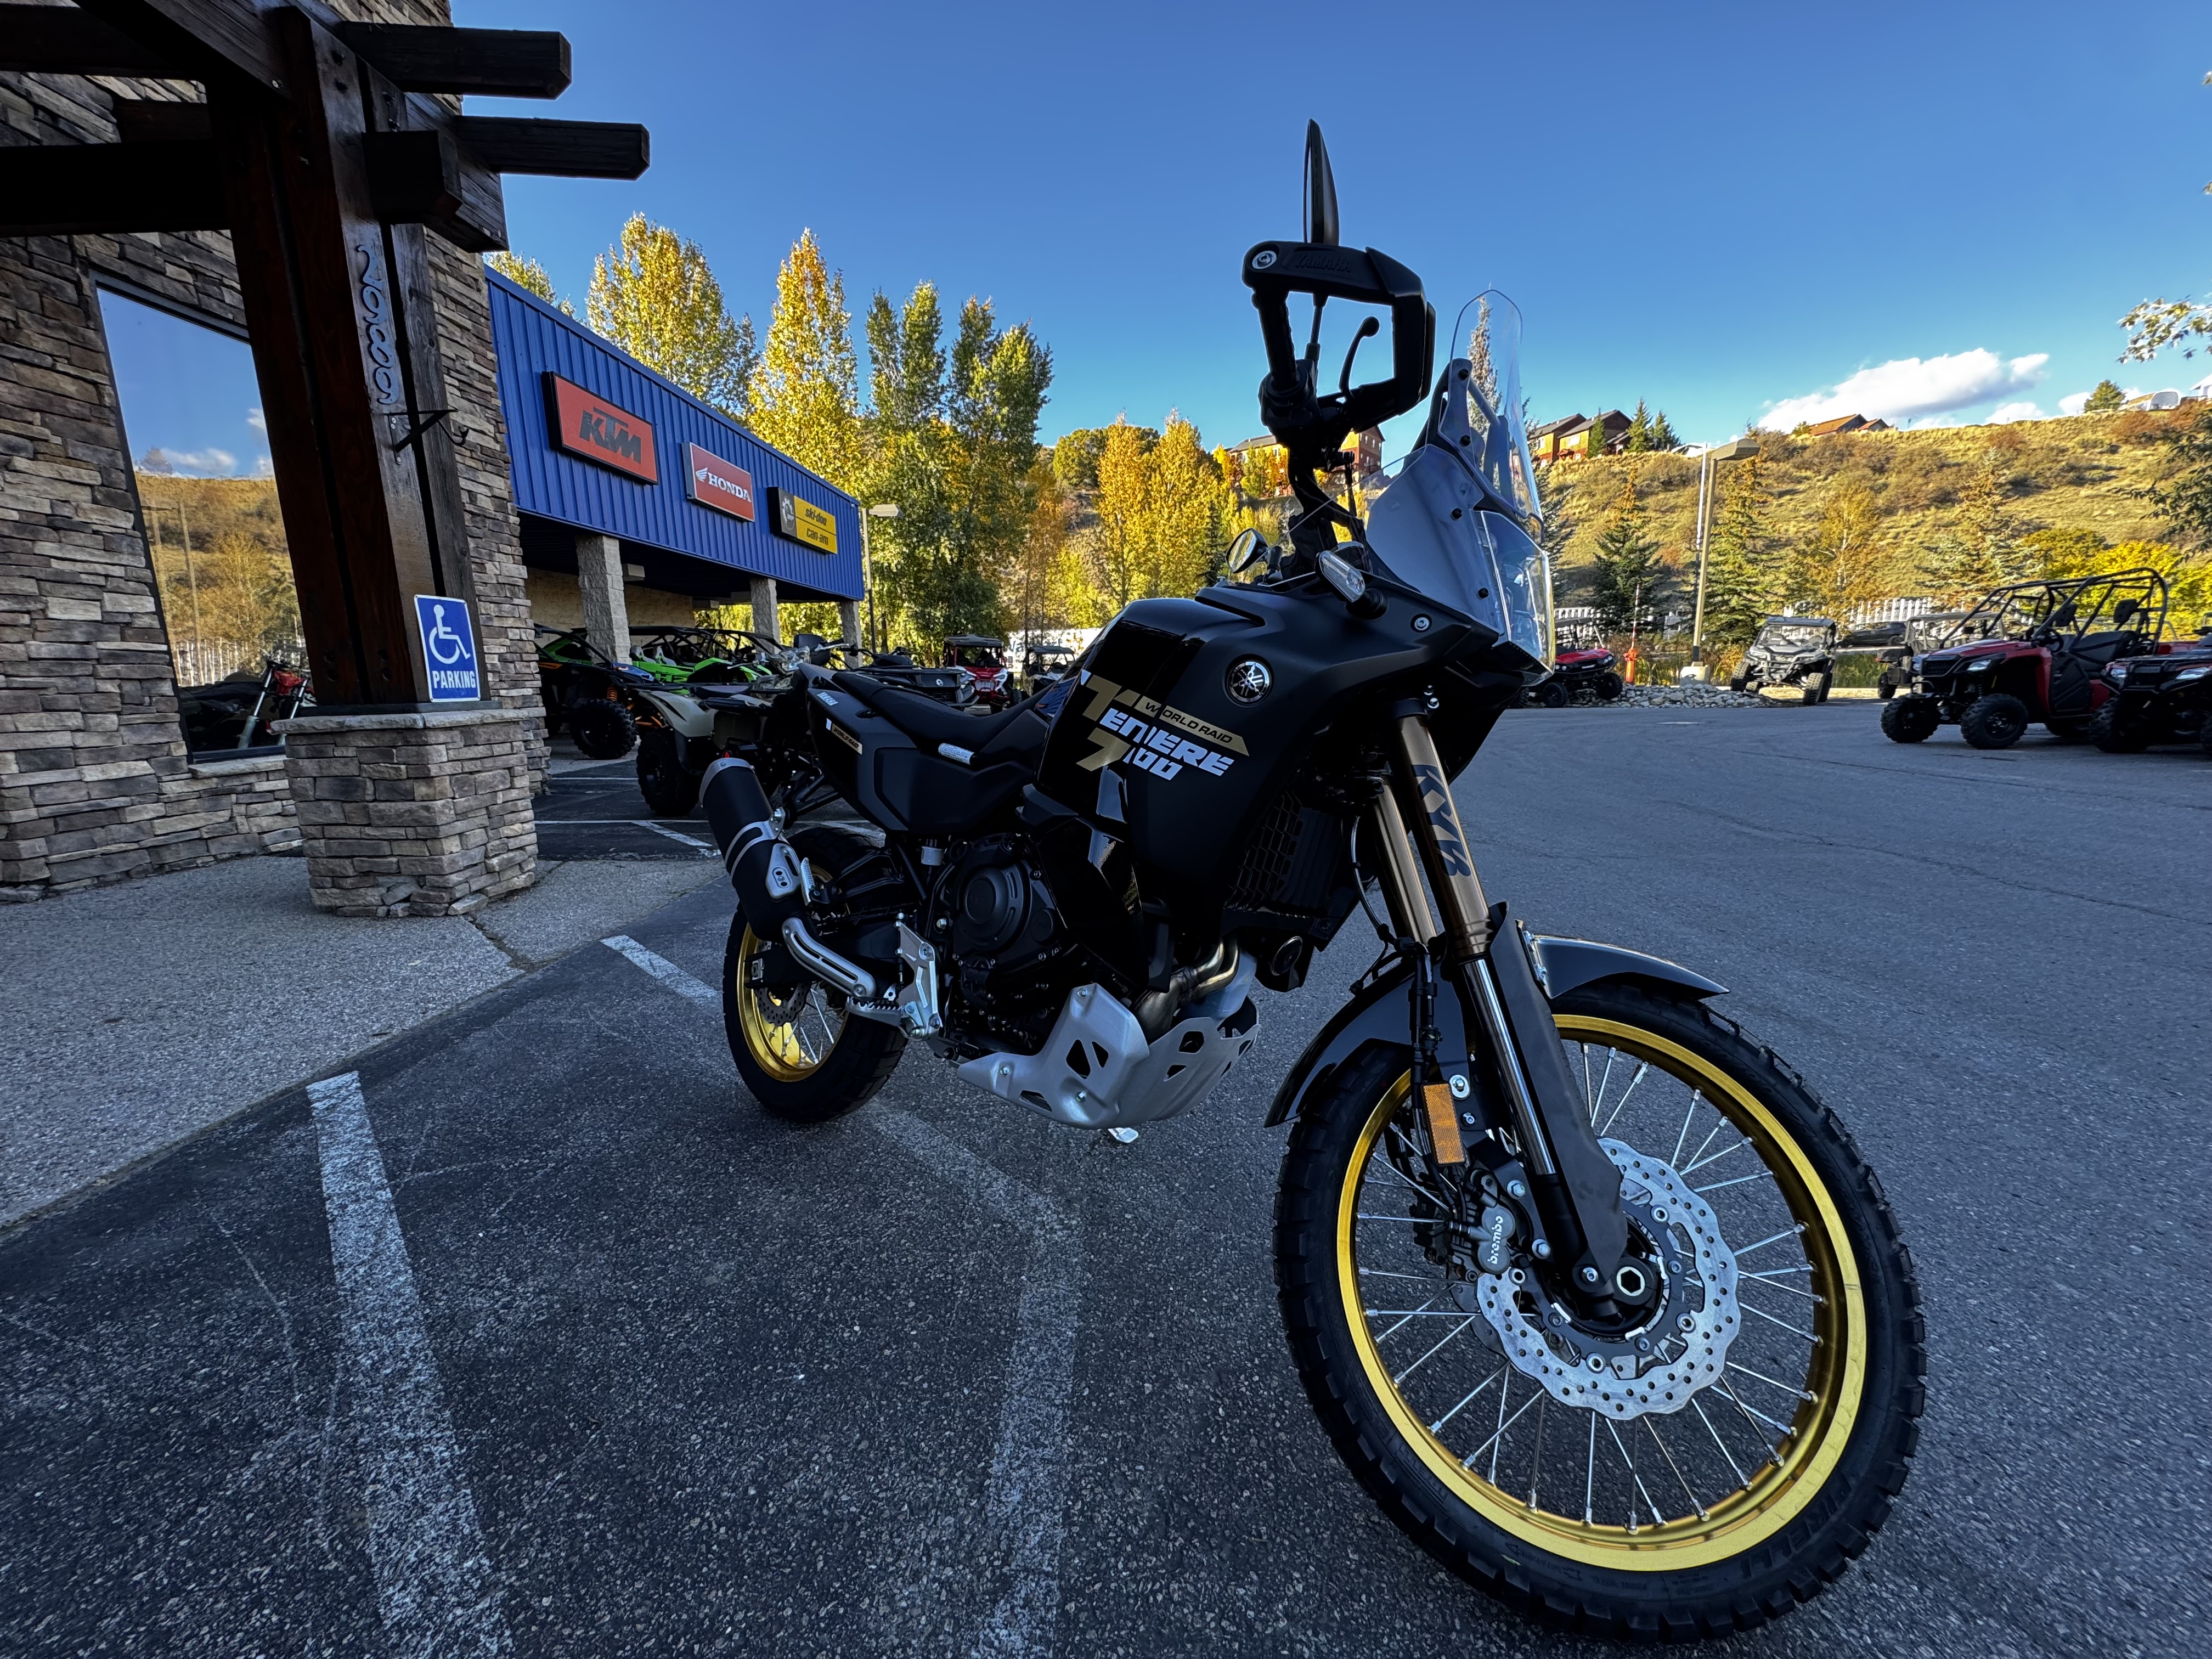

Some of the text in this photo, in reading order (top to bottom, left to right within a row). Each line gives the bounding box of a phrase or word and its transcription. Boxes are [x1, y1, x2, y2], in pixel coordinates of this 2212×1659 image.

[1294, 254, 1352, 273] YAMAHA
[356, 245, 399, 405] 2989
[579, 407, 641, 464] KTM
[707, 472, 752, 503] HONDA
[805, 507, 827, 526] ski-doo
[806, 528, 829, 546] can-am
[432, 670, 476, 689] PARKING
[833, 727, 860, 749] WORLD RAID
[1144, 702, 1233, 743] WORLD RAID
[1409, 764, 1471, 877] KYB
[1487, 1216, 1503, 1265] brembo
